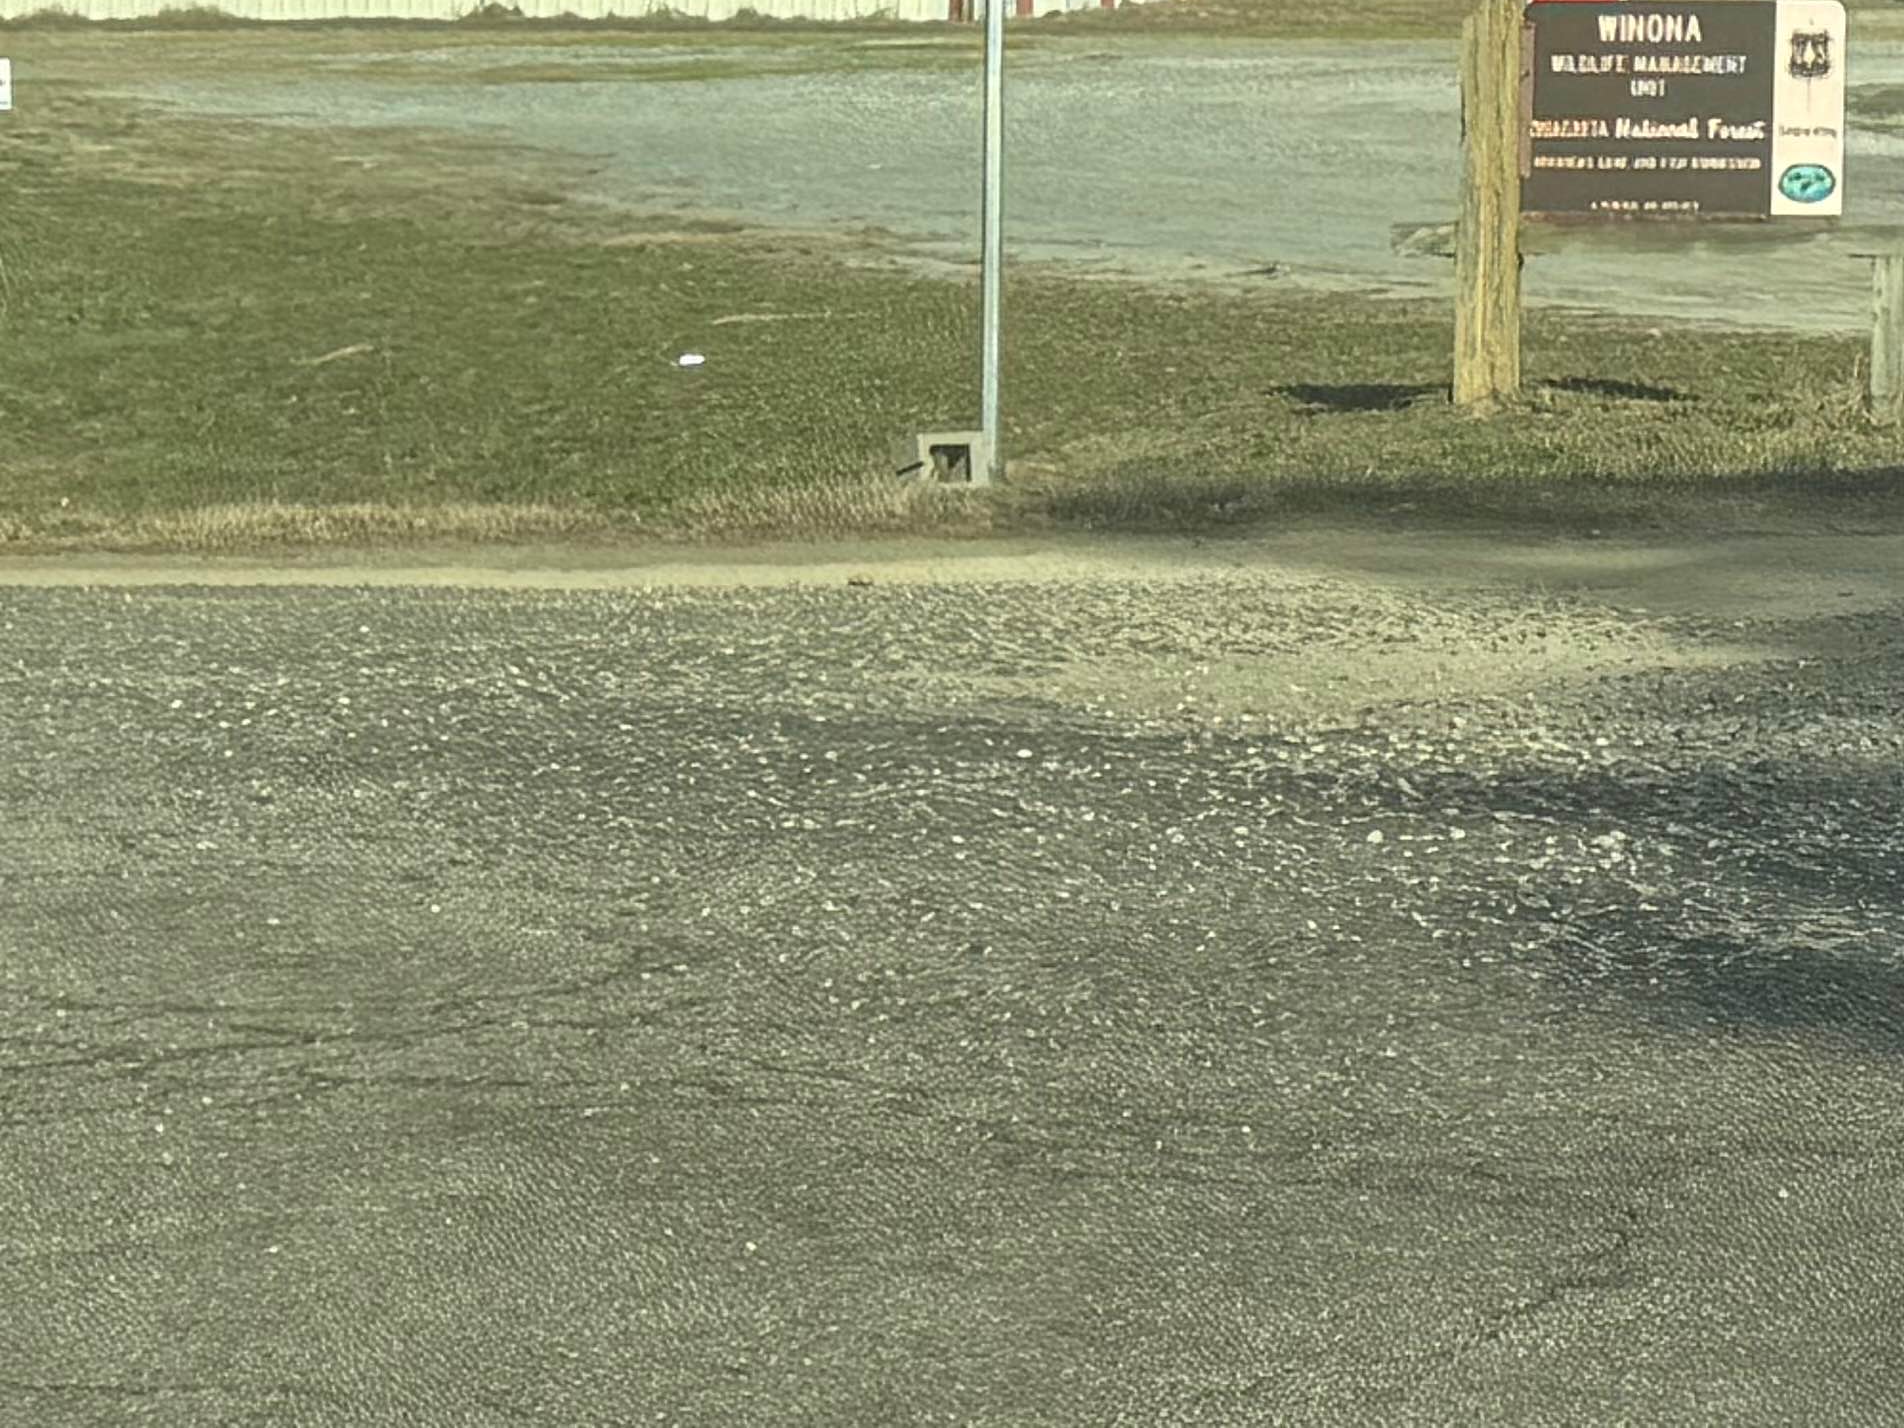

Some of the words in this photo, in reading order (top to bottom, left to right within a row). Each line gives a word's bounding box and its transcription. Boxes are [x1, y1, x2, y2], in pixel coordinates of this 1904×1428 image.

[1598, 14, 1701, 42] WINONA
[1615, 117, 1699, 139] National
[1707, 118, 1766, 139] Forest
